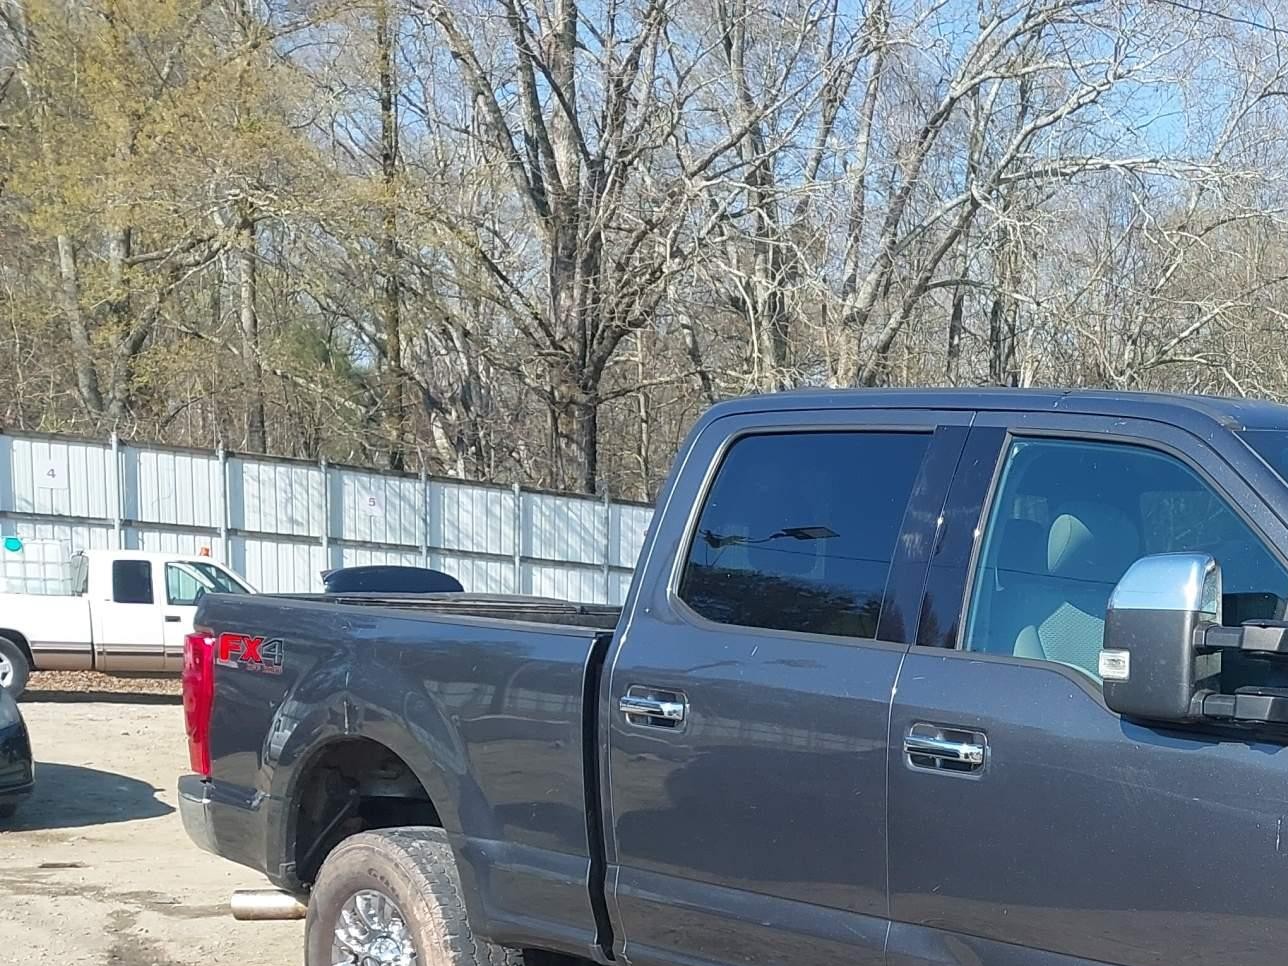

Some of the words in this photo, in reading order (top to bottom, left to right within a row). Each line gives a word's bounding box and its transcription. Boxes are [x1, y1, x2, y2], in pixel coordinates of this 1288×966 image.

[46, 468, 57, 479] 4
[368, 497, 376, 507] 5
[219, 632, 285, 666] FX4
